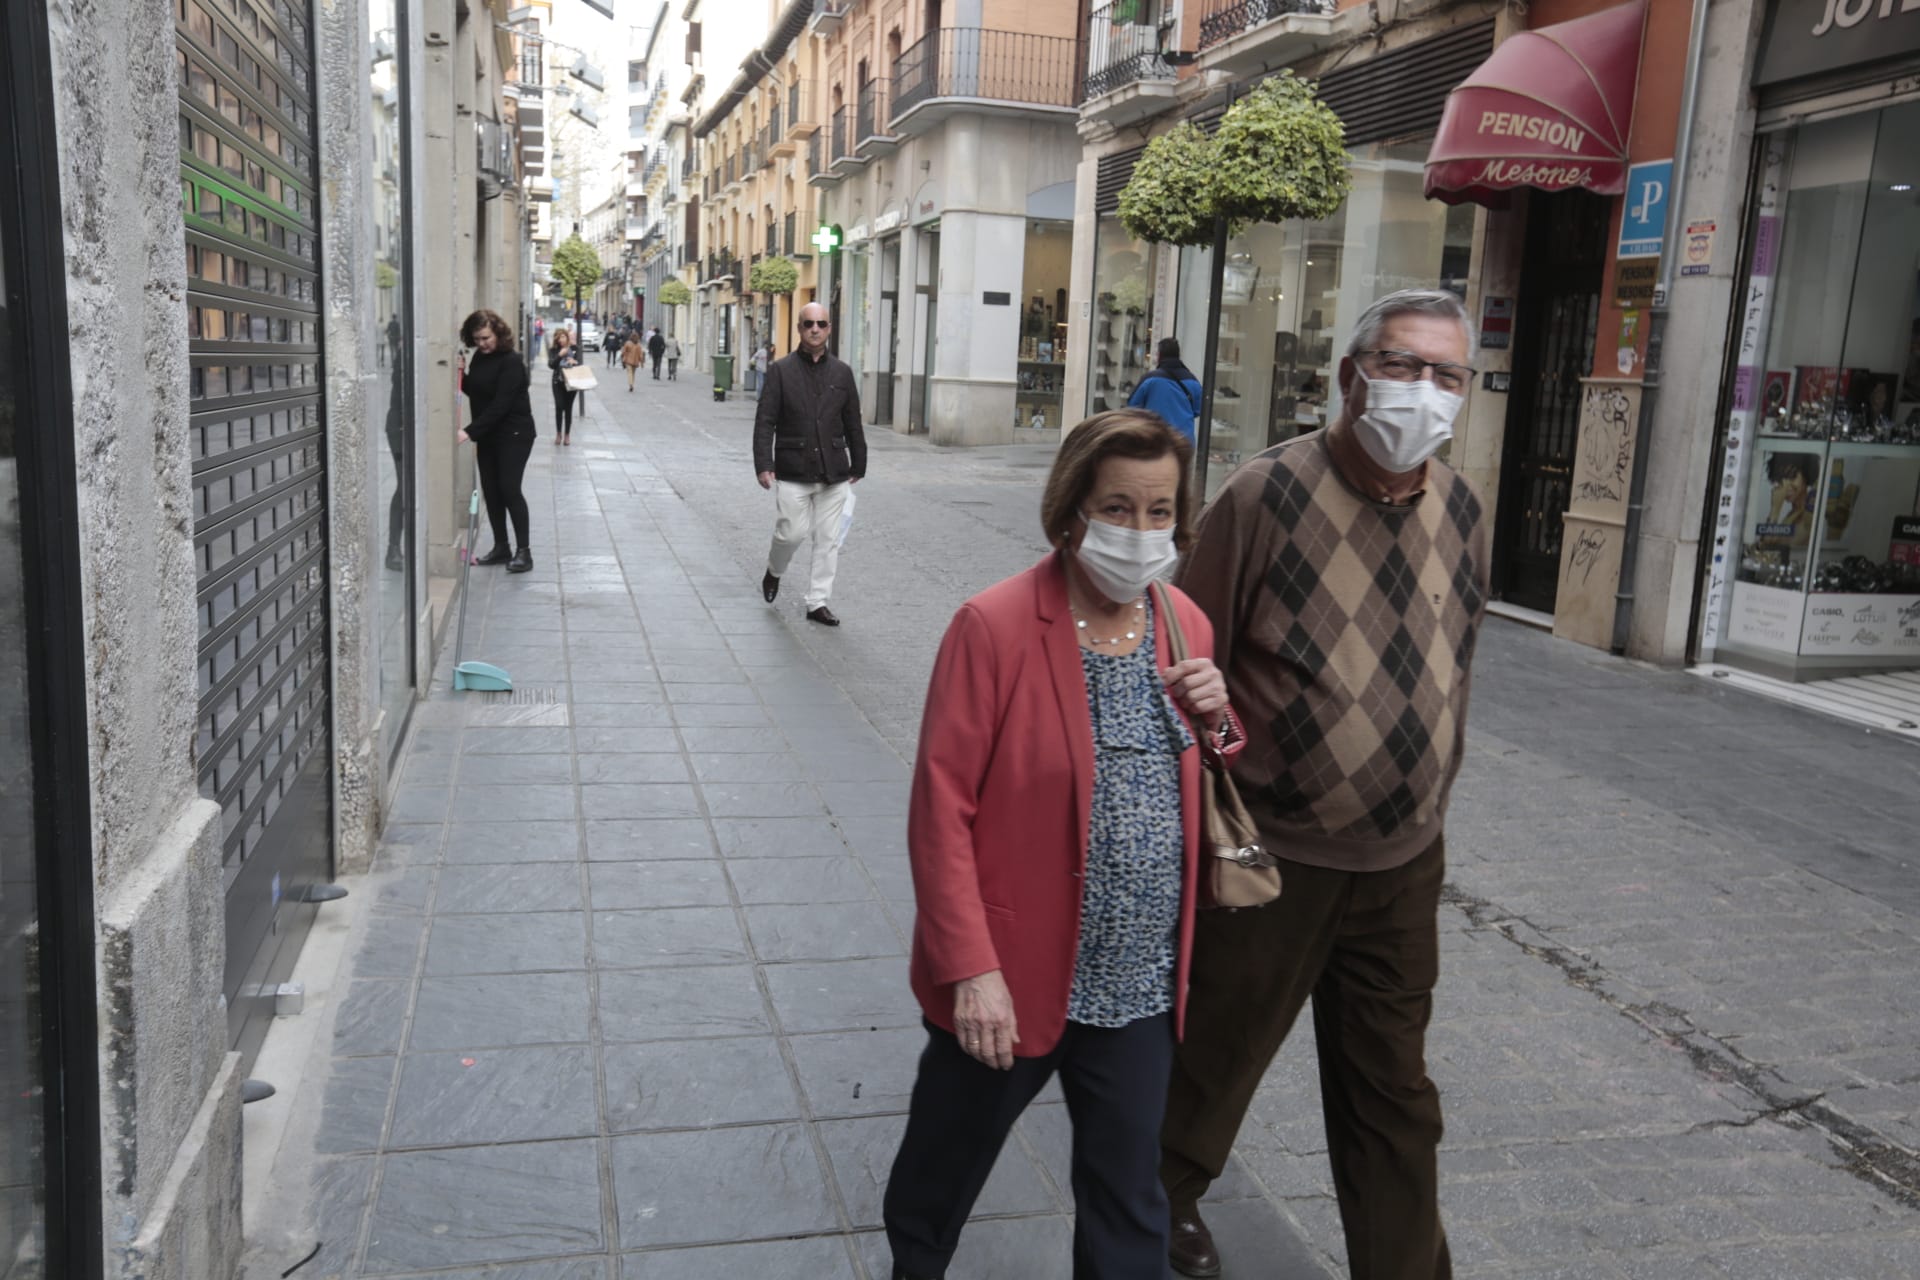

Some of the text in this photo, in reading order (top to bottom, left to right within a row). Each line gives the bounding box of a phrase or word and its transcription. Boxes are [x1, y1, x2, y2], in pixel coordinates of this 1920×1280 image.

[1477, 111, 1585, 153] PENSION
[1472, 160, 1592, 186] Mesones
[1637, 181, 1663, 224] P
[1758, 525, 1791, 535] CASIO
